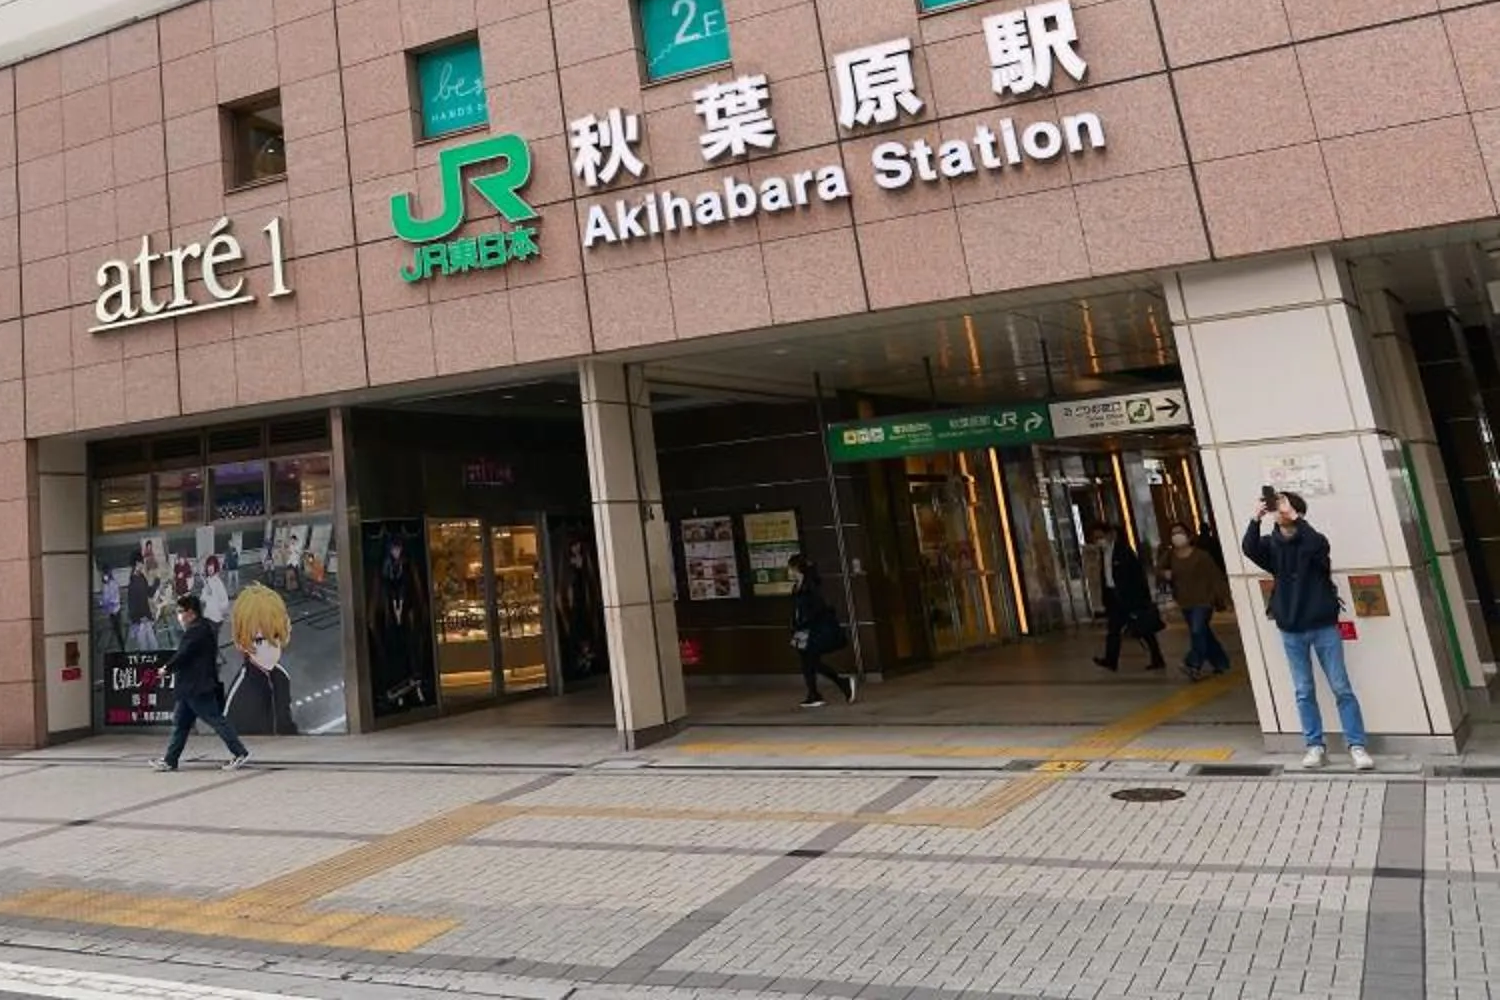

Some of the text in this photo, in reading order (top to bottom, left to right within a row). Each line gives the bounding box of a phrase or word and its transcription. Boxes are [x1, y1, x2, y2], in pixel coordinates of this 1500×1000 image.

[390, 132, 541, 244] JR
[584, 111, 1106, 247] Akihabara Station
[95, 216, 293, 325] atré 1
[400, 225, 542, 285] JR東日本
[994, 411, 1018, 428] JR
